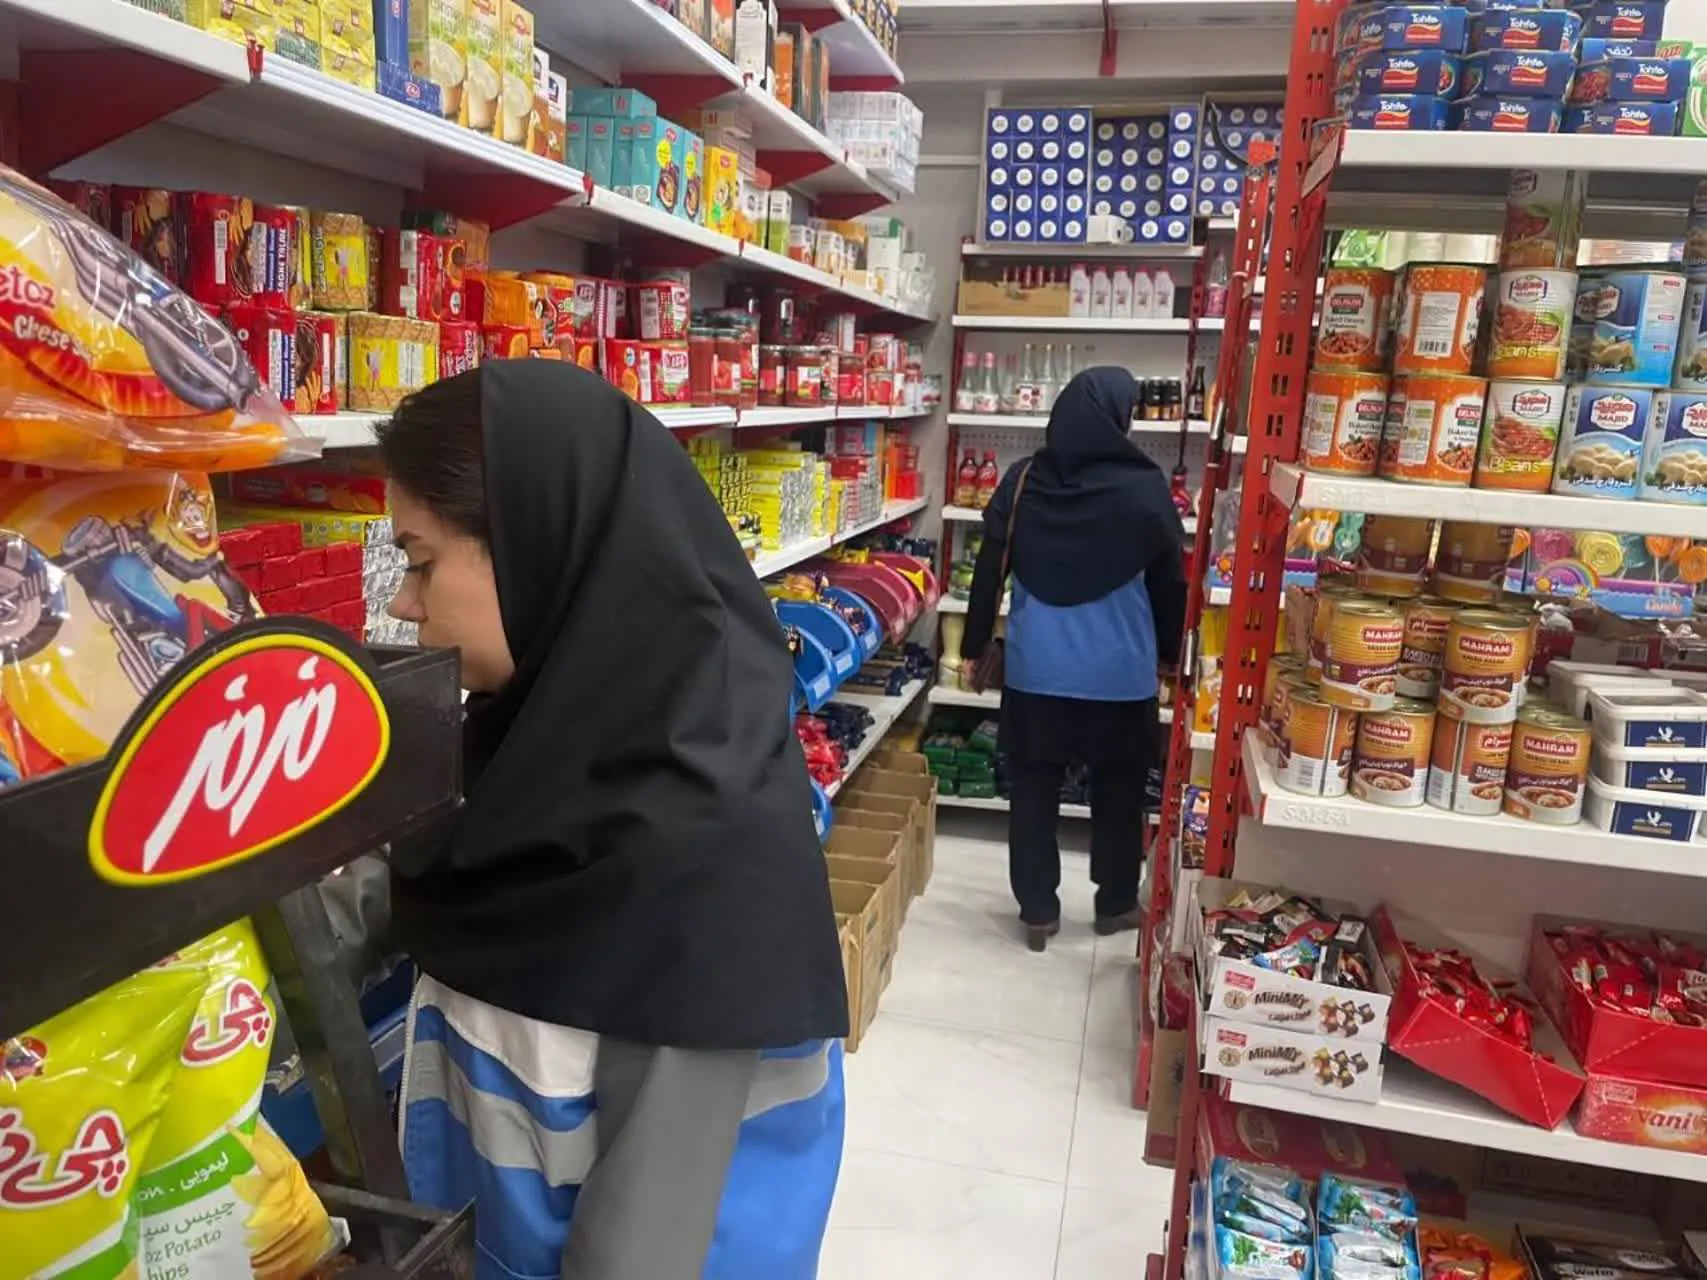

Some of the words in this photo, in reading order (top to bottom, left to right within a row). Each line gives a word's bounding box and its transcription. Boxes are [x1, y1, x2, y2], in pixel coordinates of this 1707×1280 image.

[1365, 629, 1401, 639] MAHRA
[1461, 638, 1511, 654] MAHRAM
[1526, 739, 1574, 755] MAHRAM
[142, 655, 338, 874] مزمز
[164, 1229, 222, 1259] Potato
